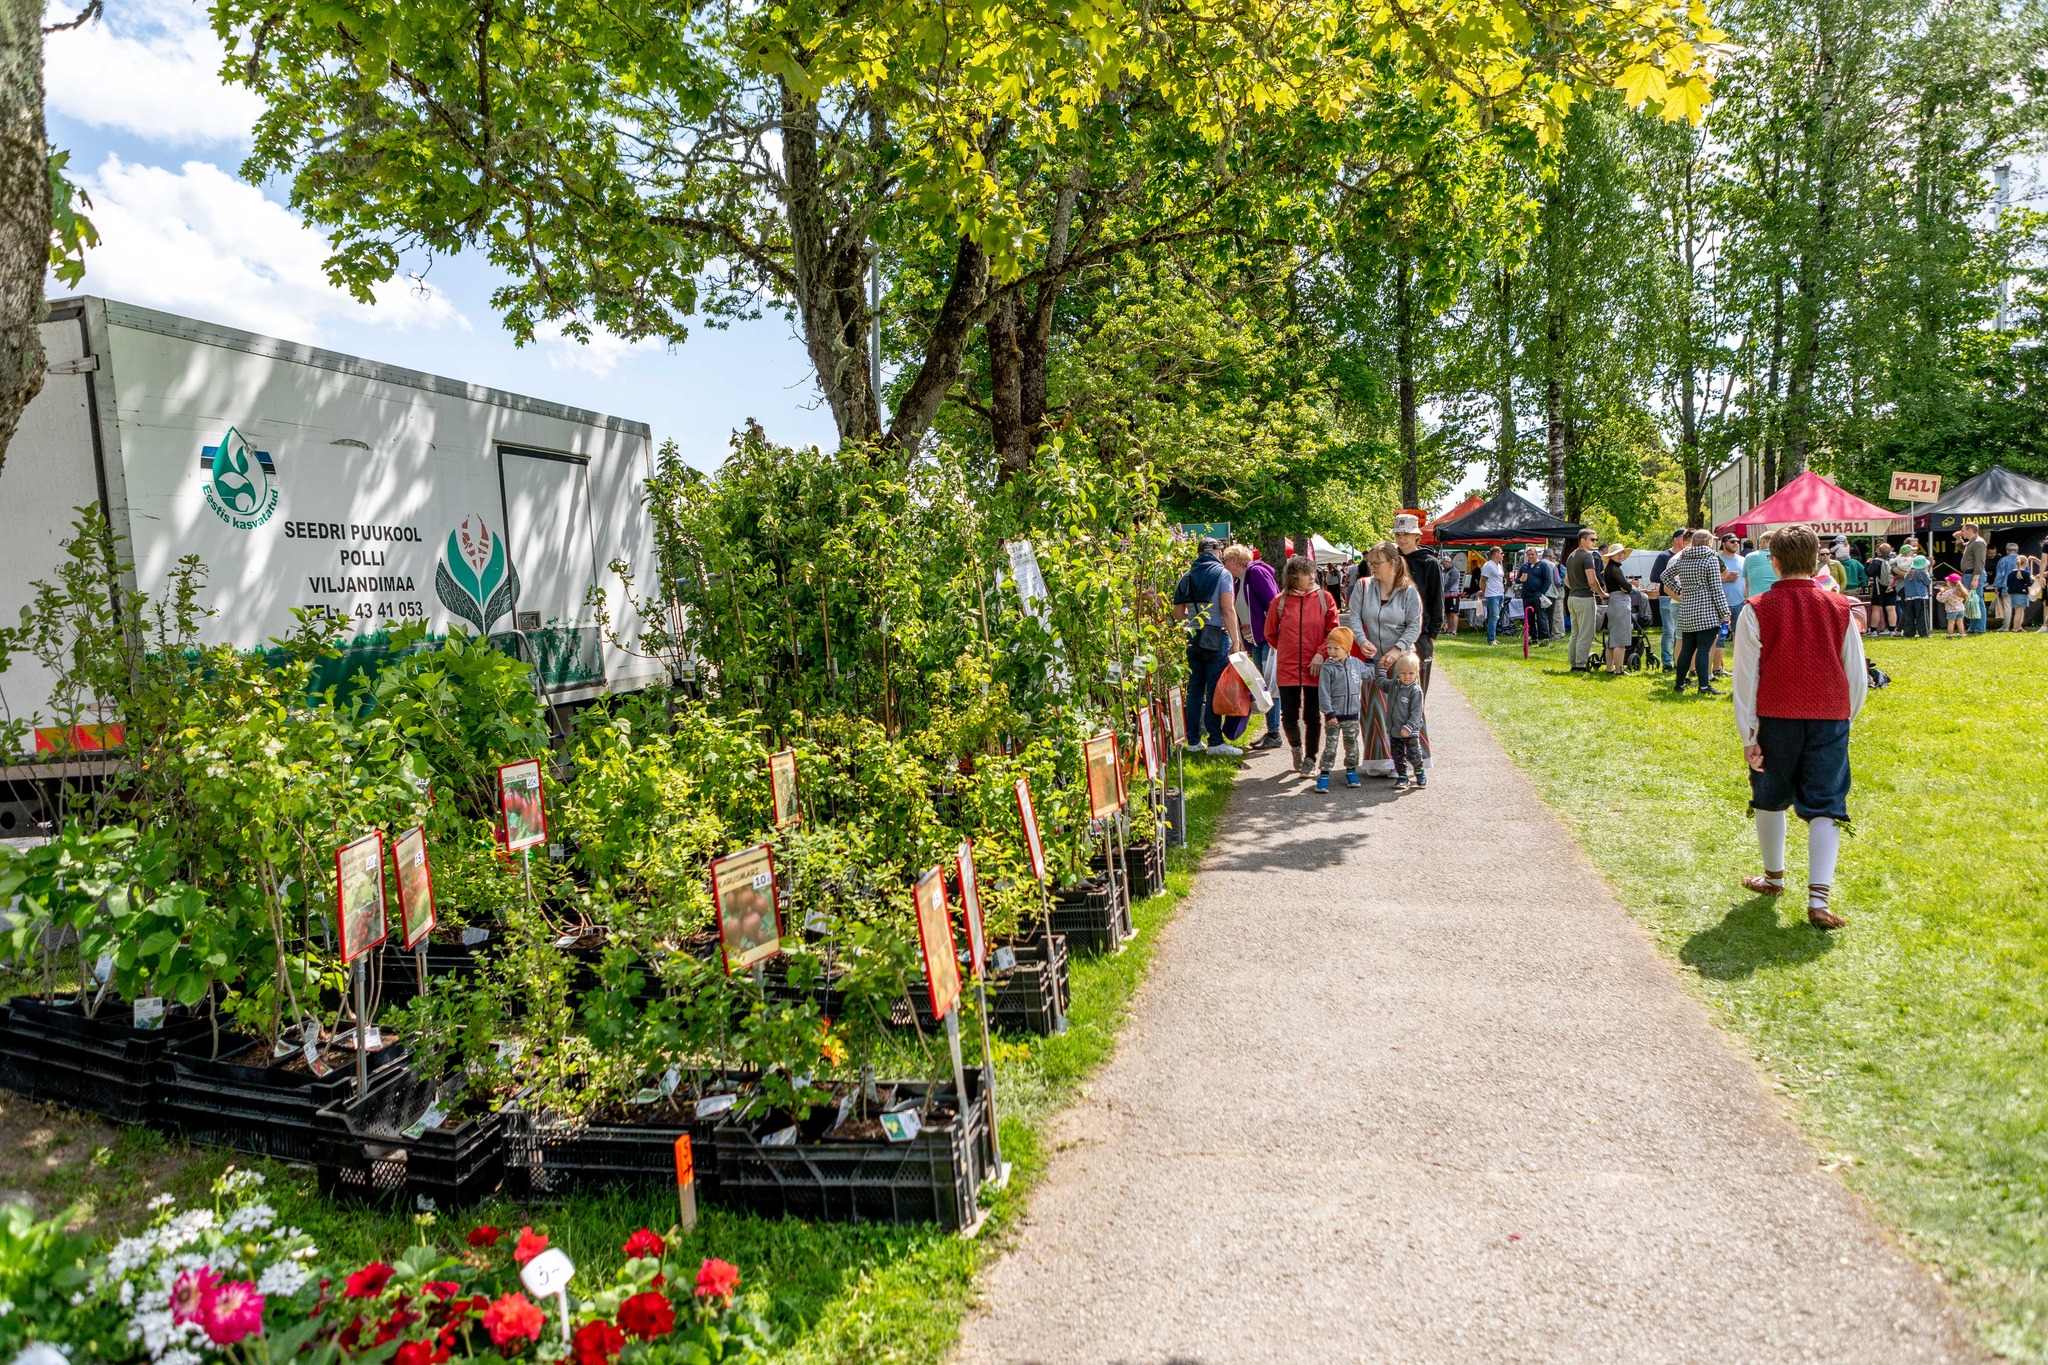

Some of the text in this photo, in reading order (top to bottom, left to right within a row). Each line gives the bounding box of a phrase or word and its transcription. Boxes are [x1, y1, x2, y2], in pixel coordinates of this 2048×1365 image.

[1895, 477, 1937, 493] KALI
[202, 485, 278, 530] Eestis kasvatatud
[1805, 521, 1868, 534] DUKALI
[1961, 518, 1990, 526] JAANI
[1991, 515, 2018, 524] TALU
[284, 521, 422, 542] SEEDRI PUUKOOL
[340, 549, 385, 566] POLLI
[308, 576, 415, 594] VILJANDIMAA
[355, 602, 373, 619] 43
[377, 602, 393, 618] 41
[399, 601, 423, 617] 053
[755, 874, 767, 887] 10
